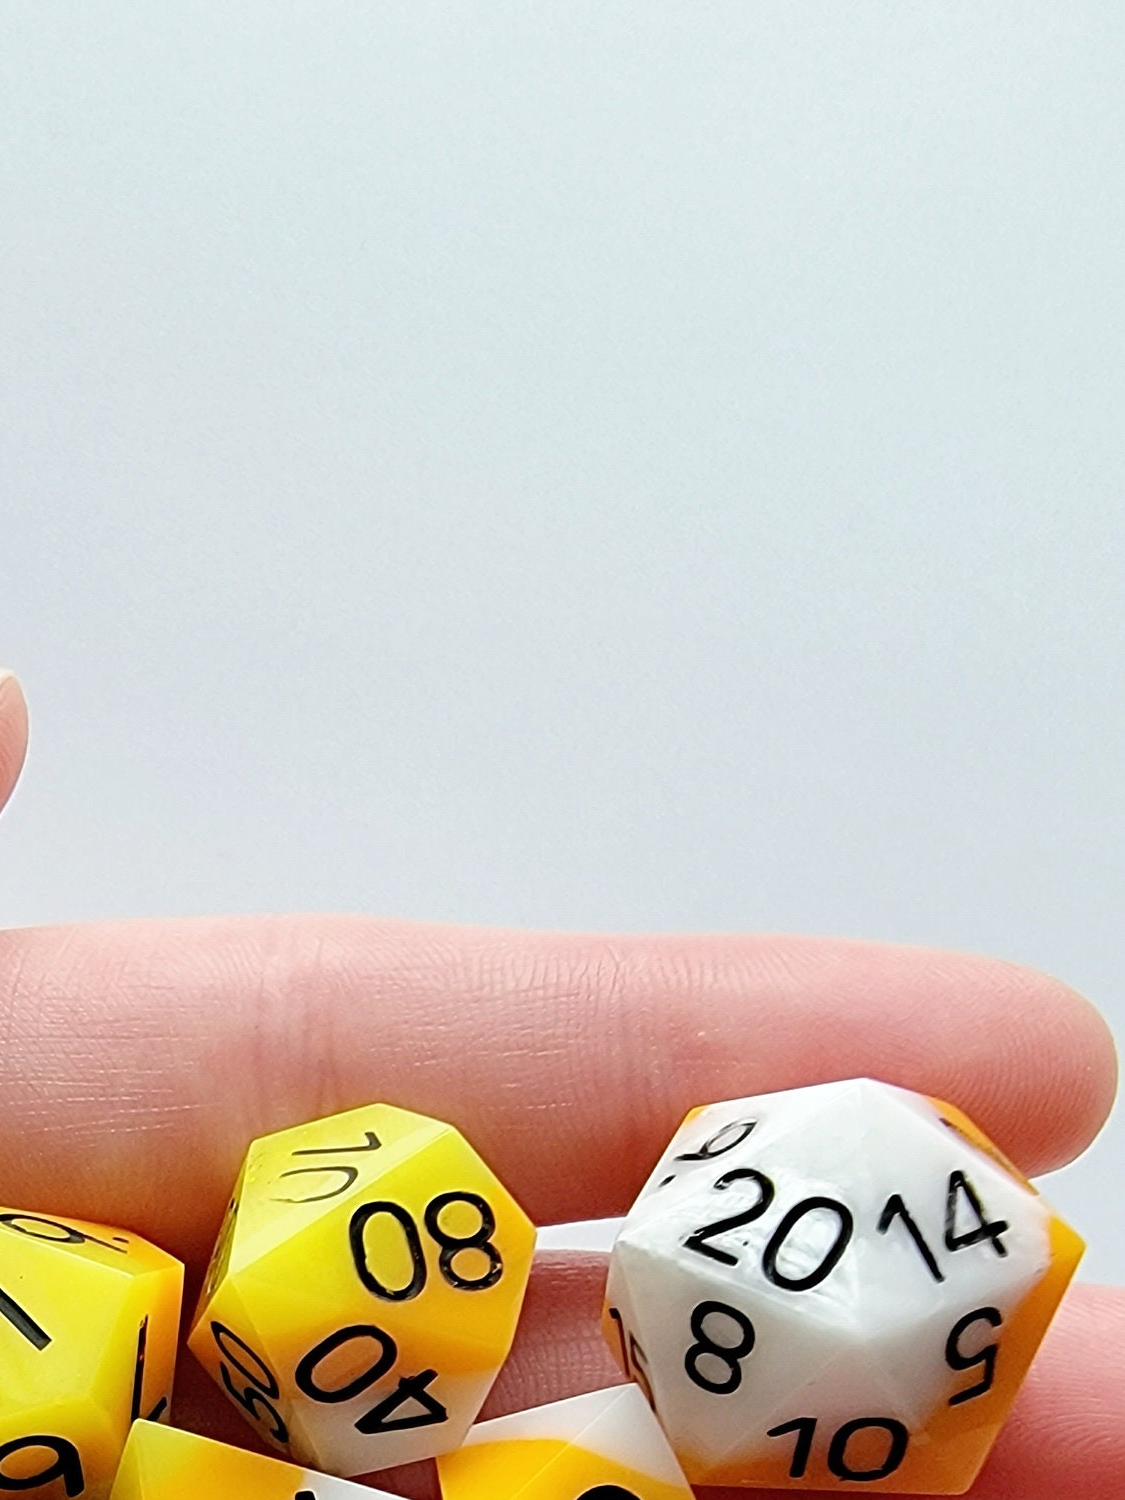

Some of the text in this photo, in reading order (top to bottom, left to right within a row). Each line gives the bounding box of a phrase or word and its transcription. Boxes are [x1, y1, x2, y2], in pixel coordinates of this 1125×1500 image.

[269, 1131, 382, 1204] 10
[681, 1167, 854, 1292] 20
[878, 1169, 1009, 1284] 14
[294, 1324, 449, 1435] 40
[684, 1300, 756, 1395] 8
[766, 1417, 910, 1482] 10
